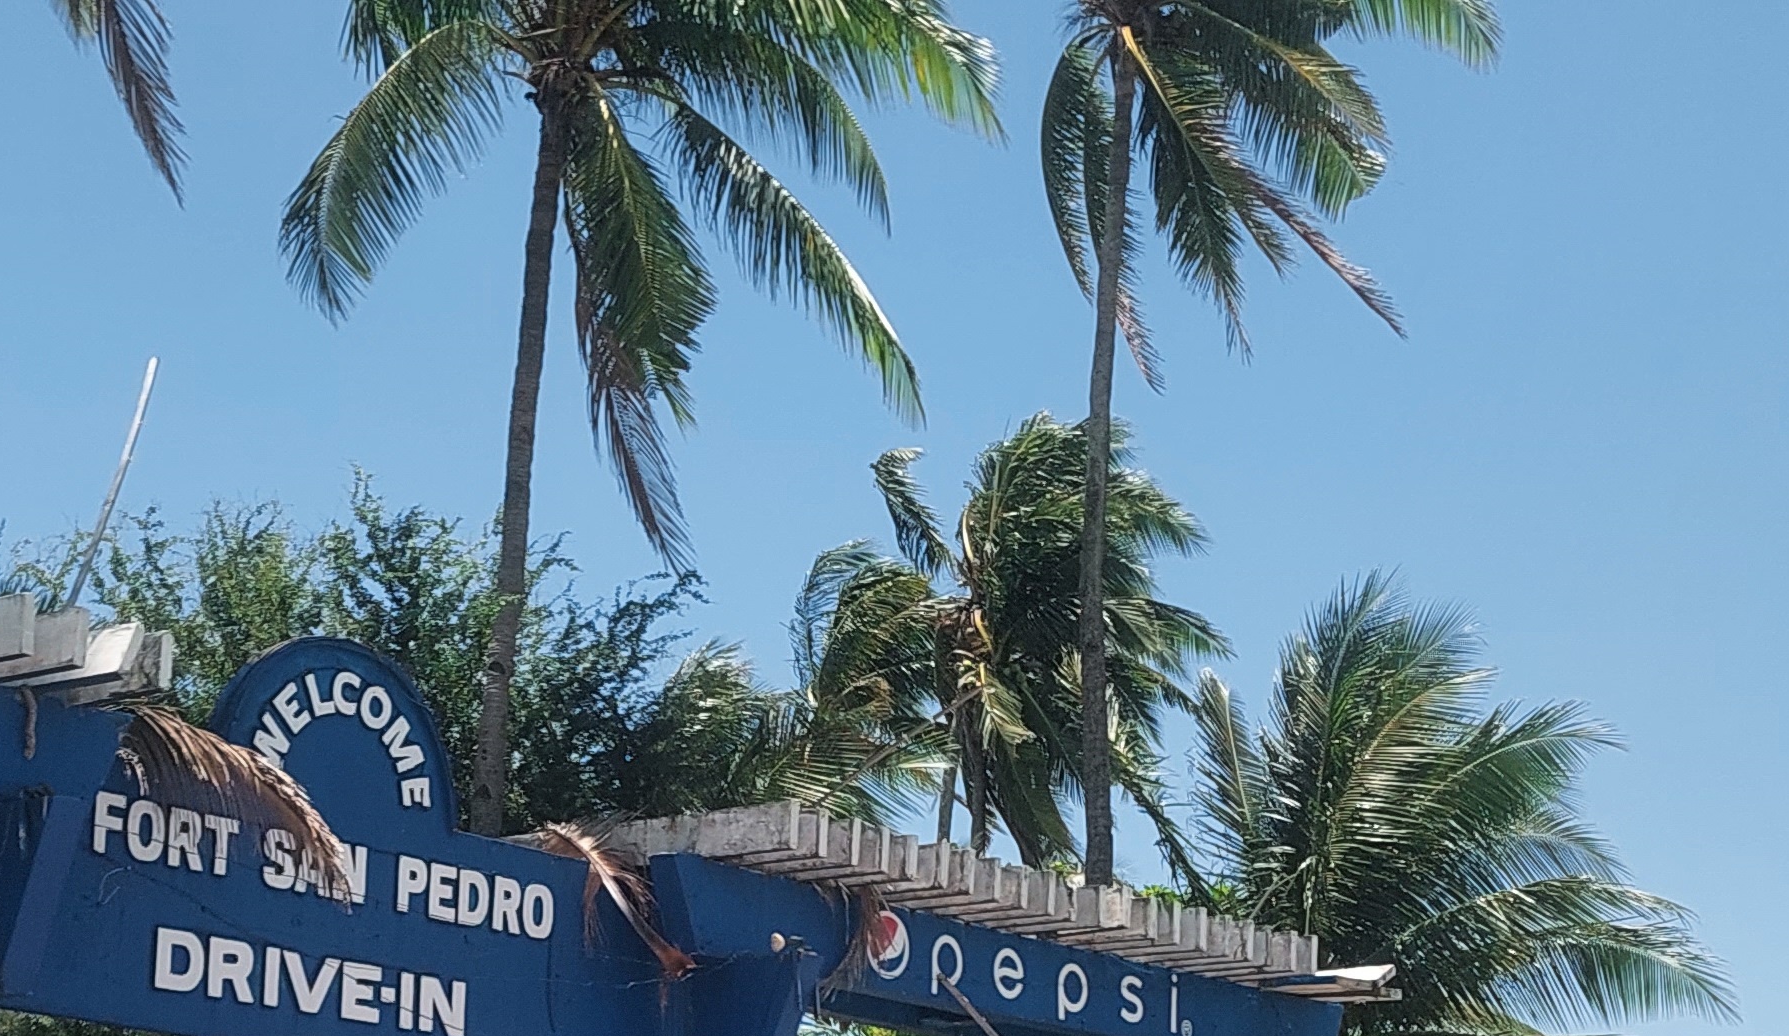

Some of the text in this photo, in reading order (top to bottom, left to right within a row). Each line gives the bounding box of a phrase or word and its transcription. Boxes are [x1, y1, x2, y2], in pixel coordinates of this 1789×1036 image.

[253, 671, 432, 808] WELCOME
[92, 790, 240, 876] FORT
[396, 855, 554, 939] PEDRO
[931, 934, 1179, 1034] pepsi
